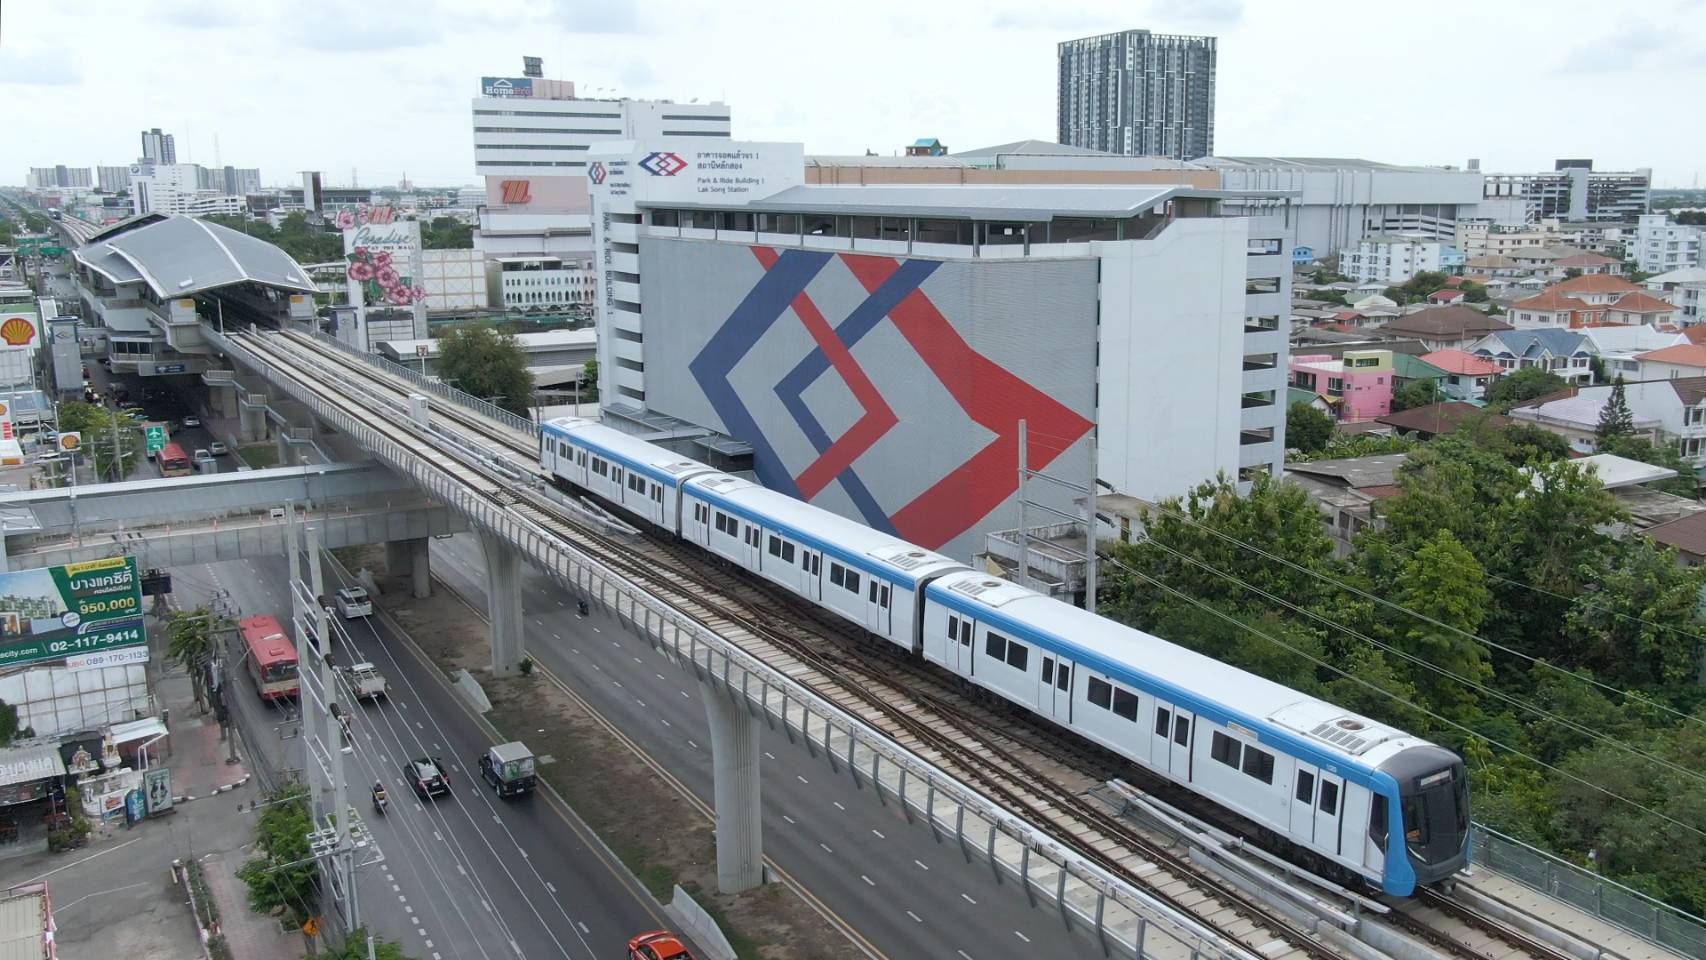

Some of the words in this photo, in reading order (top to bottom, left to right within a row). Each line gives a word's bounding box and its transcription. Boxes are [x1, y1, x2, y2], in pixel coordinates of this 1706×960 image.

[697, 150, 752, 159] อาคารจอดแล้วจร
[697, 160, 743, 170] สถานีหลักสอง
[735, 177, 760, 185] Building
[710, 186, 726, 194] Song
[602, 212, 610, 231] PARK
[79, 597, 136, 615] 950,000
[50, 629, 139, 652] 02-117-9414
